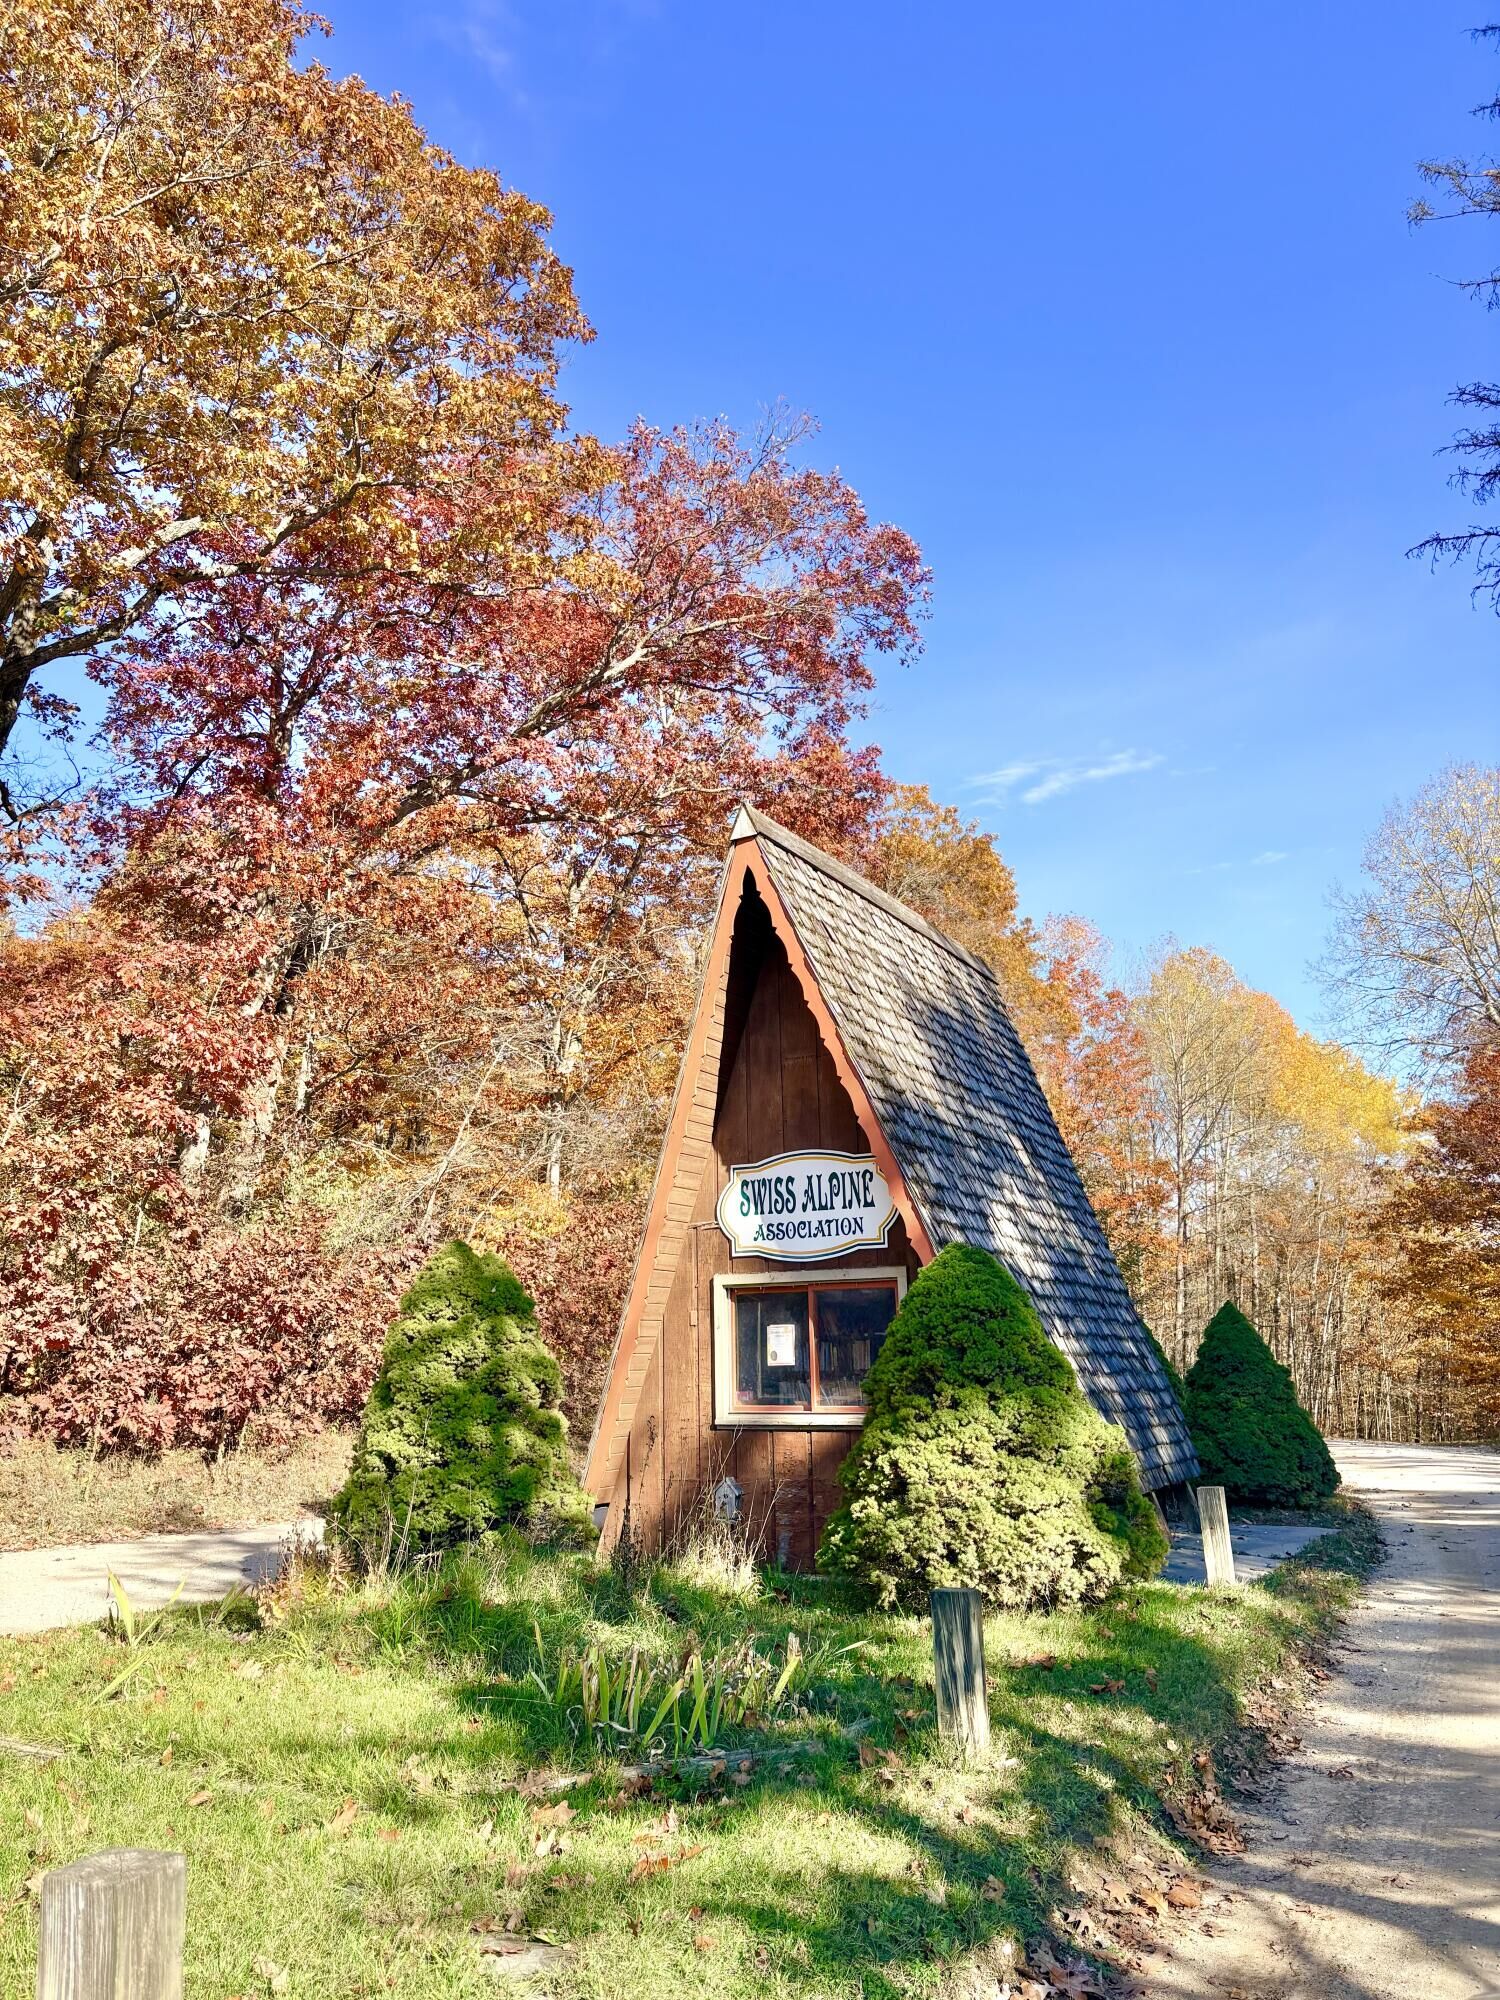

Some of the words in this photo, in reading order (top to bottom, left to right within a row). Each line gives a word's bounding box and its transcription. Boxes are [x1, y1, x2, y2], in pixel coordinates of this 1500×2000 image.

[740, 1175, 796, 1217] SWISS
[801, 1168, 876, 1213] ALPINE
[753, 1216, 864, 1242] ASSOCIATION
